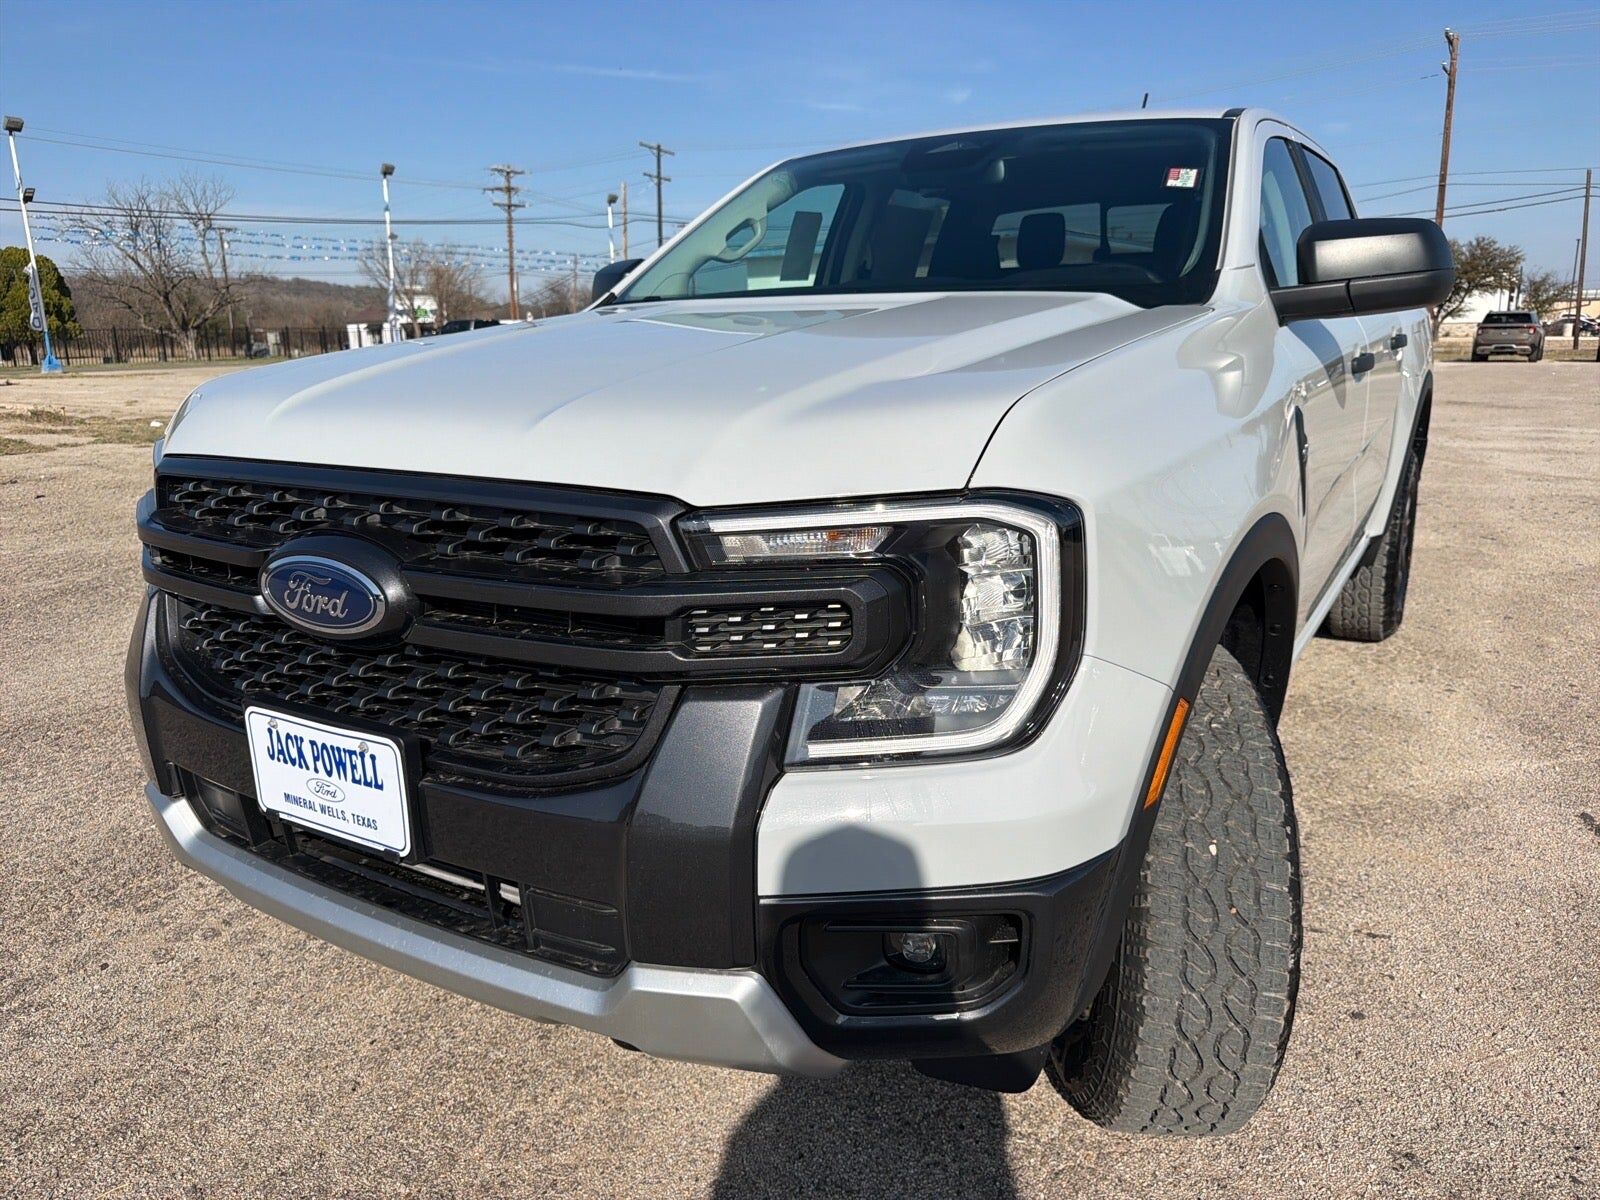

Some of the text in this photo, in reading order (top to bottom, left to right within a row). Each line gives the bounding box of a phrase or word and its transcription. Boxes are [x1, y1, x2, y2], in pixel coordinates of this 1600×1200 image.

[283, 570, 349, 618] Ford
[267, 727, 384, 791] JACK POWELL
[283, 792, 378, 831] MINERAL WELLS, TEXAS
[314, 781, 338, 799] Ford
